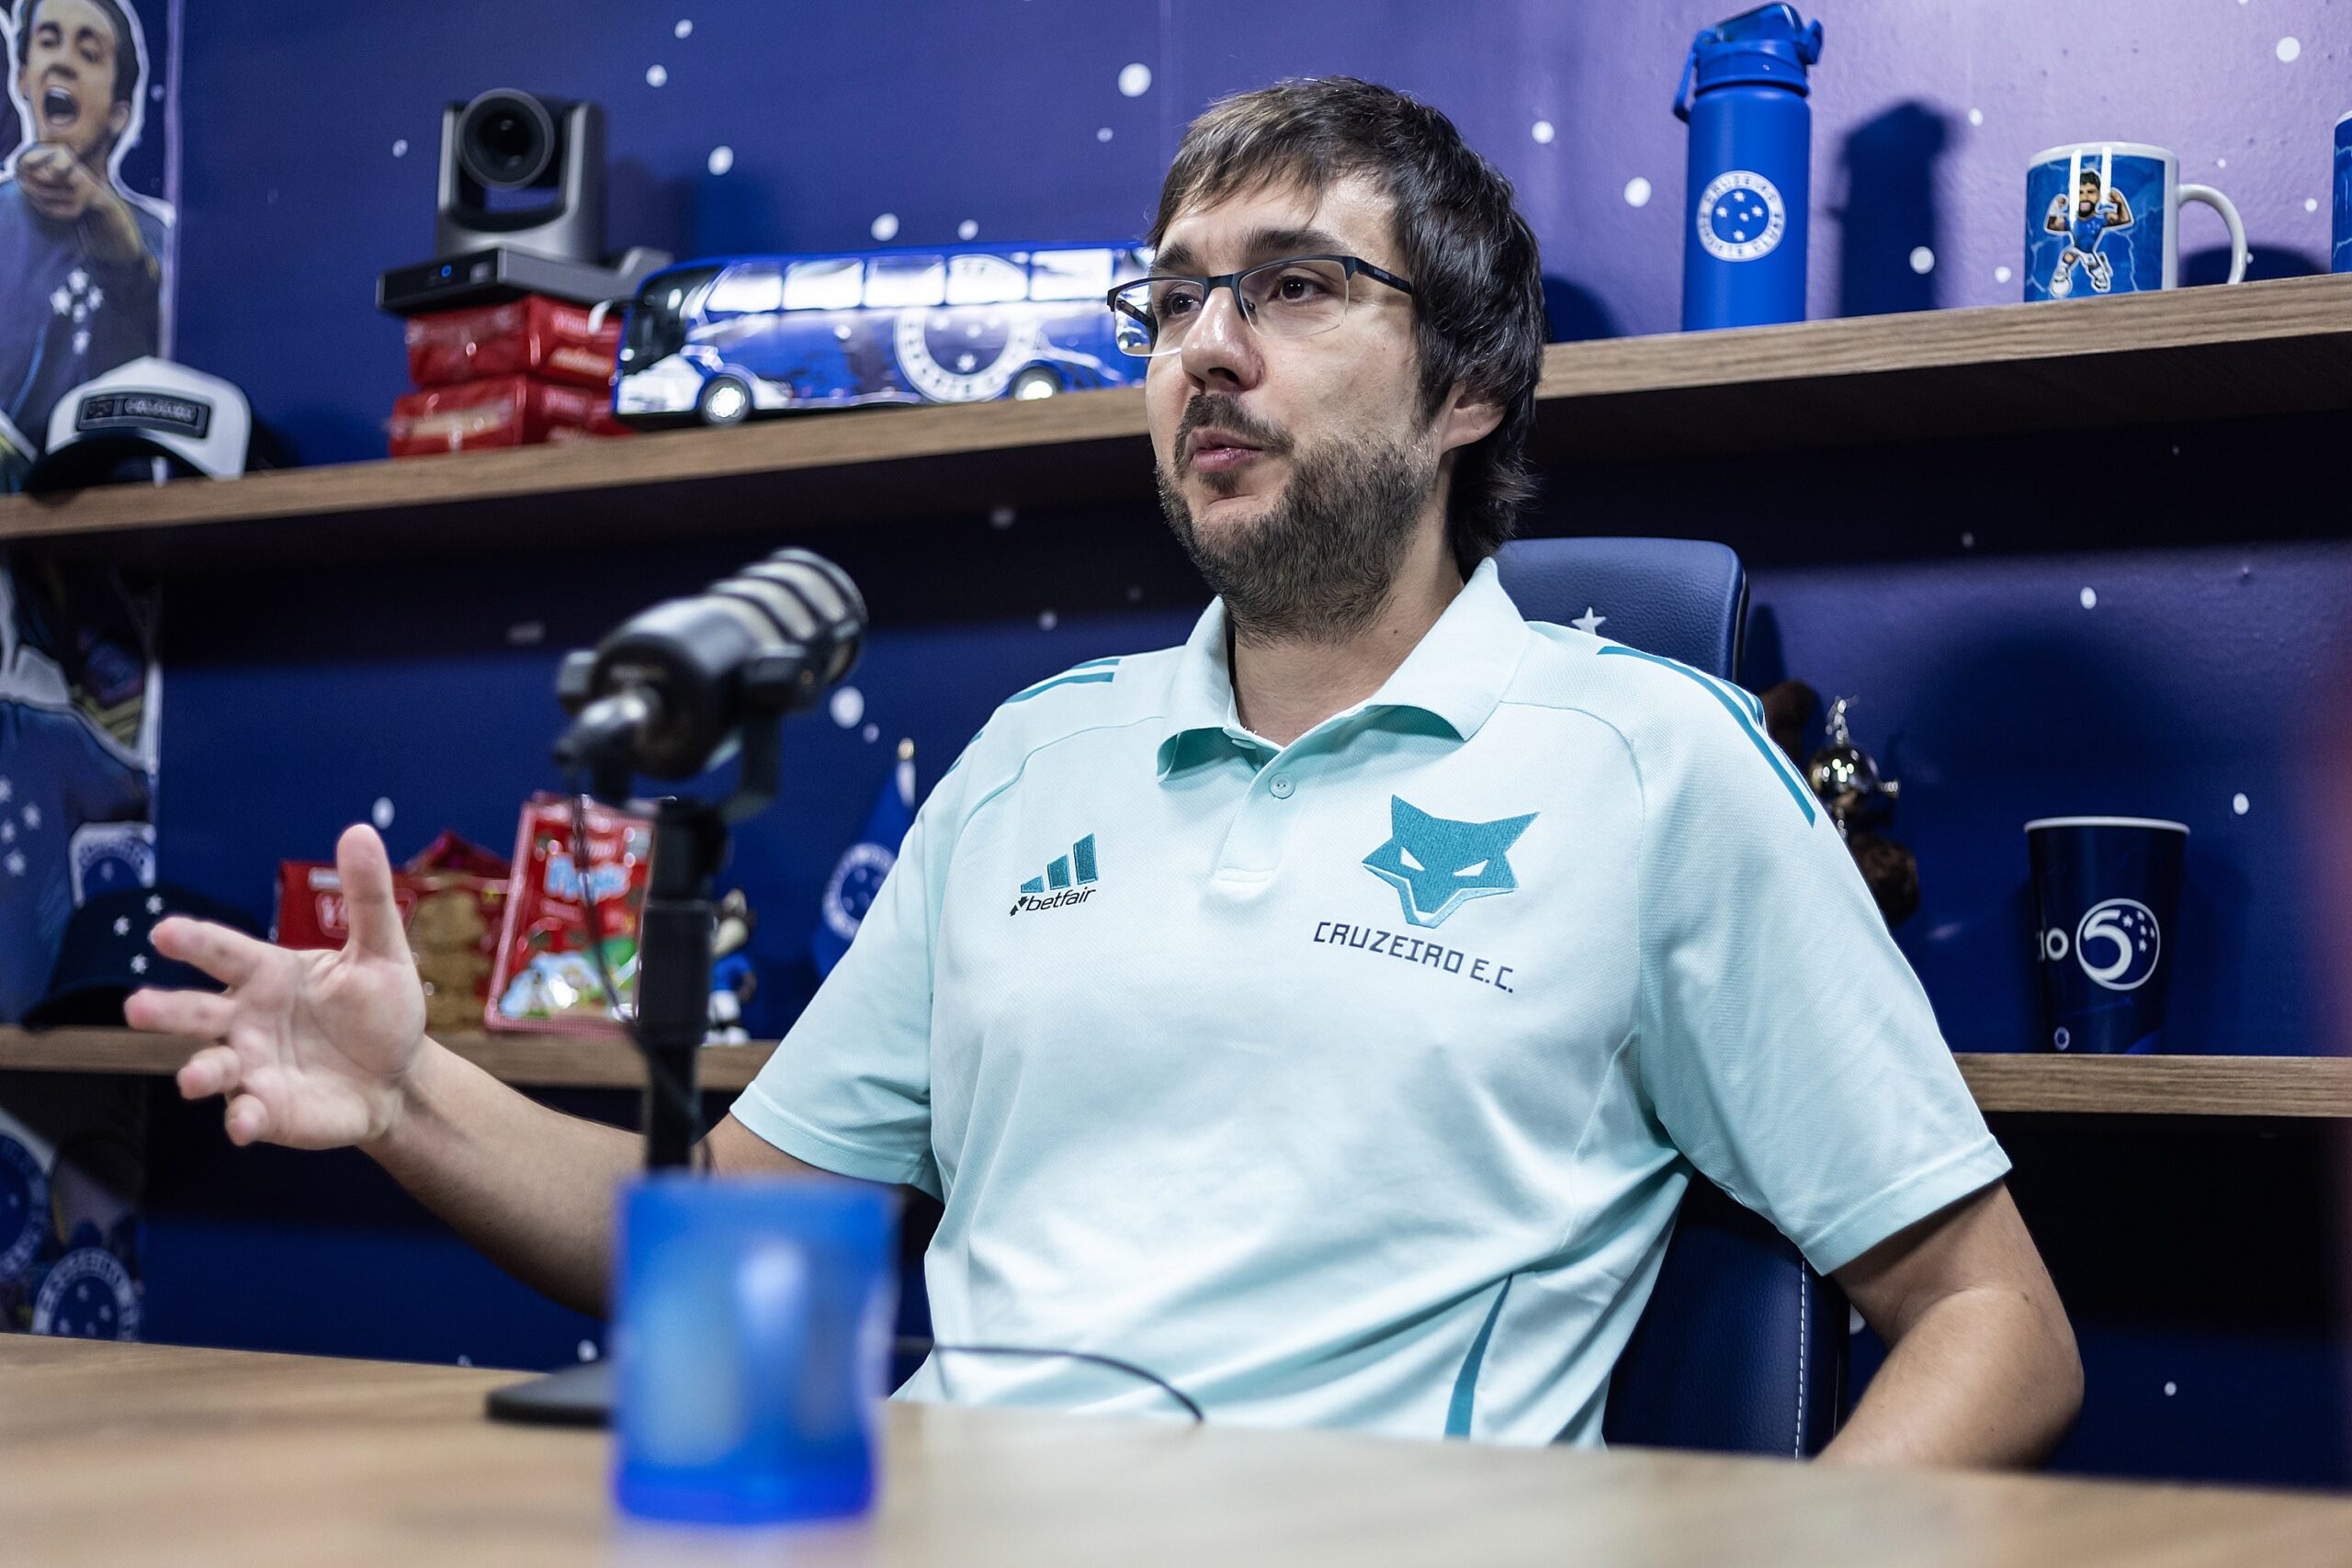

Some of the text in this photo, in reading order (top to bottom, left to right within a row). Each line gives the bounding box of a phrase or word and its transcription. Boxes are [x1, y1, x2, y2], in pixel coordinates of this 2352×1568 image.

[1026, 886, 1096, 911] betfair
[1313, 920, 1514, 994] CRUZEIRO E.C.
